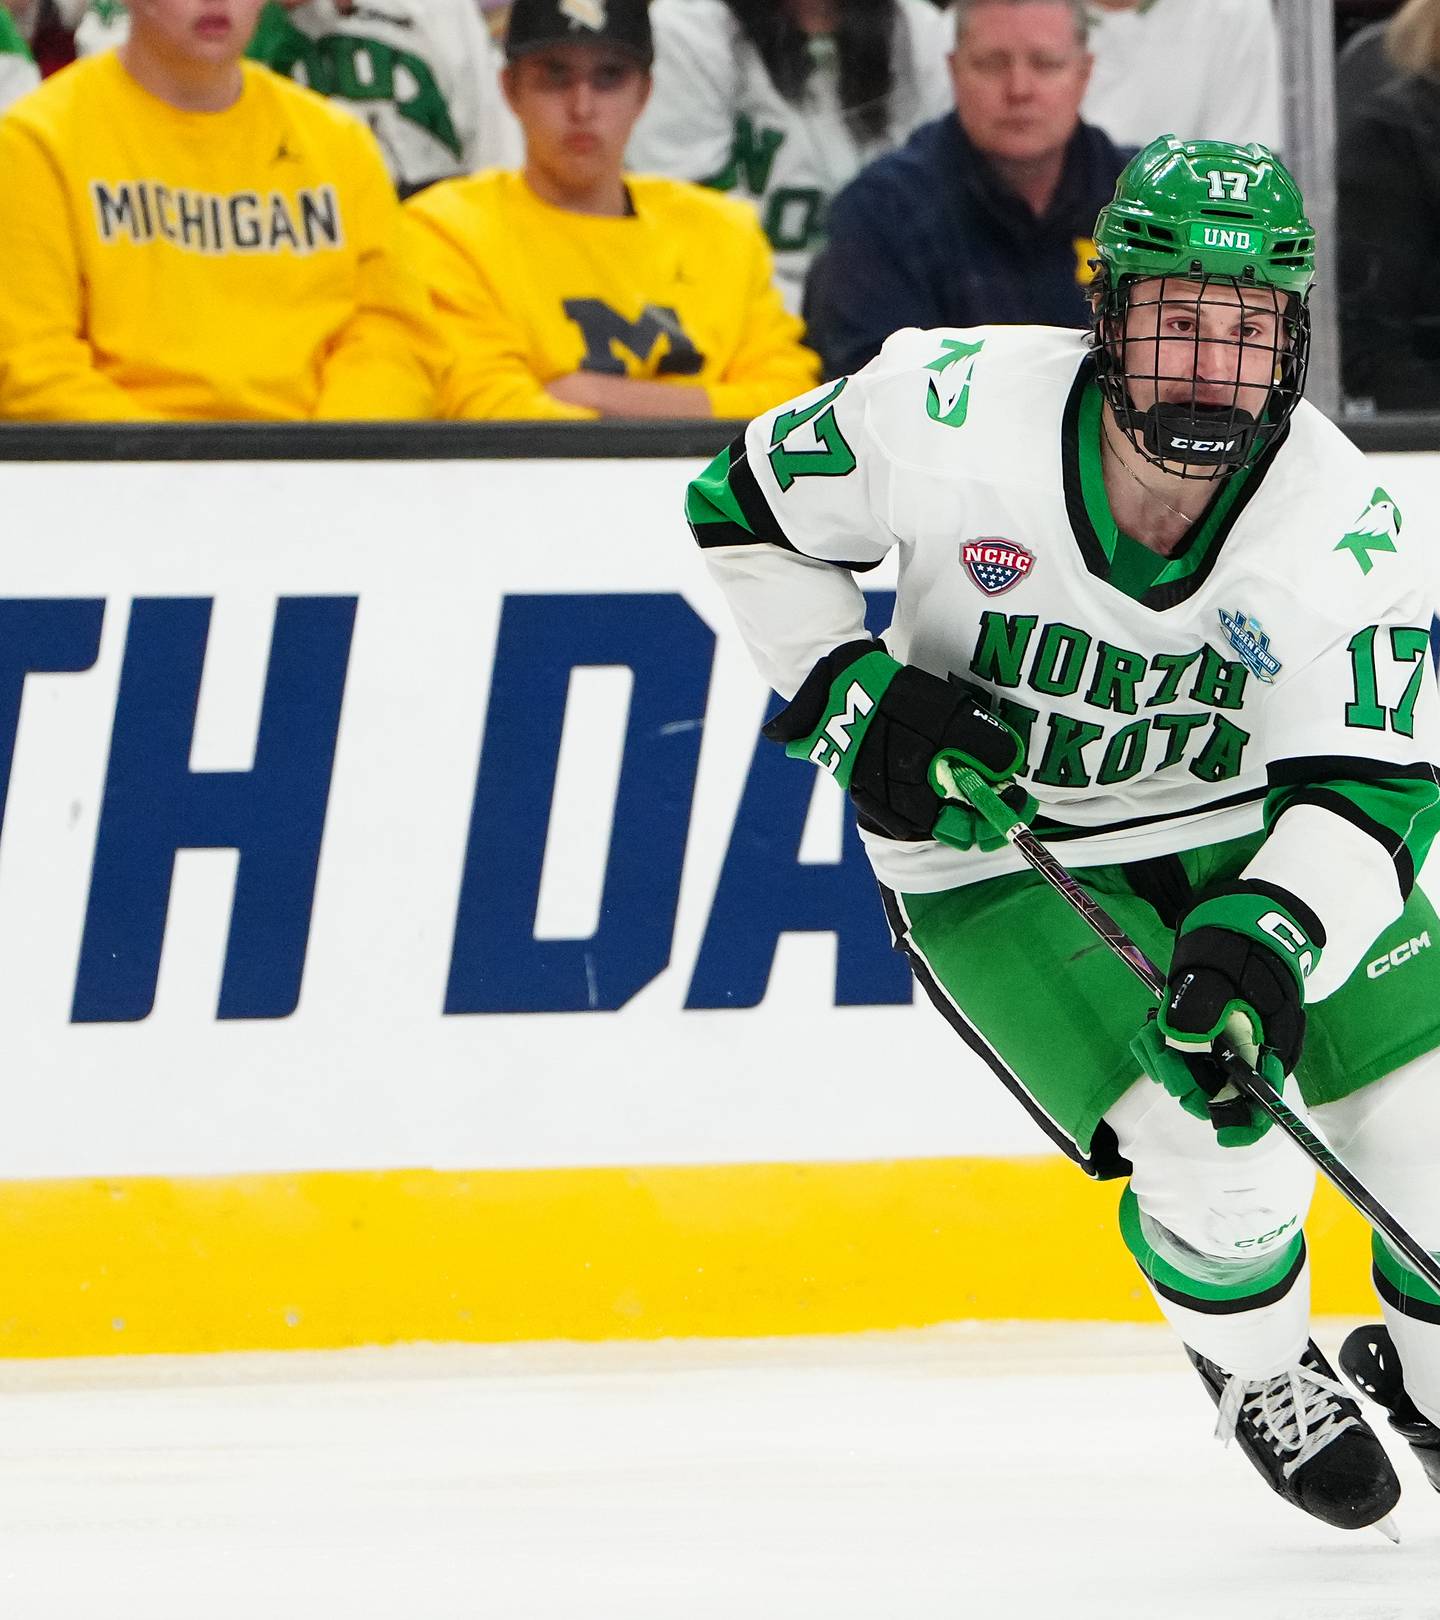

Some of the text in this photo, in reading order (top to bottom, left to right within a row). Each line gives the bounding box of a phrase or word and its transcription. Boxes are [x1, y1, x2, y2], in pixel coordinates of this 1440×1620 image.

[92, 179, 343, 256] MICHIGAN
[1206, 169, 1249, 202] 17
[1204, 227, 1250, 250] UND
[562, 298, 706, 376] M
[768, 377, 857, 492] 17
[1170, 436, 1235, 452] CCM
[965, 547, 1030, 572] NCHC
[969, 610, 1250, 715] NORTH
[1224, 617, 1255, 650] FROZEN
[1254, 646, 1276, 670] FOUR
[1345, 624, 1430, 739] 17
[809, 680, 875, 775] CM
[948, 671, 1250, 788] KOTA
[0, 592, 359, 1024] H
[1366, 930, 1431, 979] CCM
[1234, 1214, 1298, 1248] CCM
